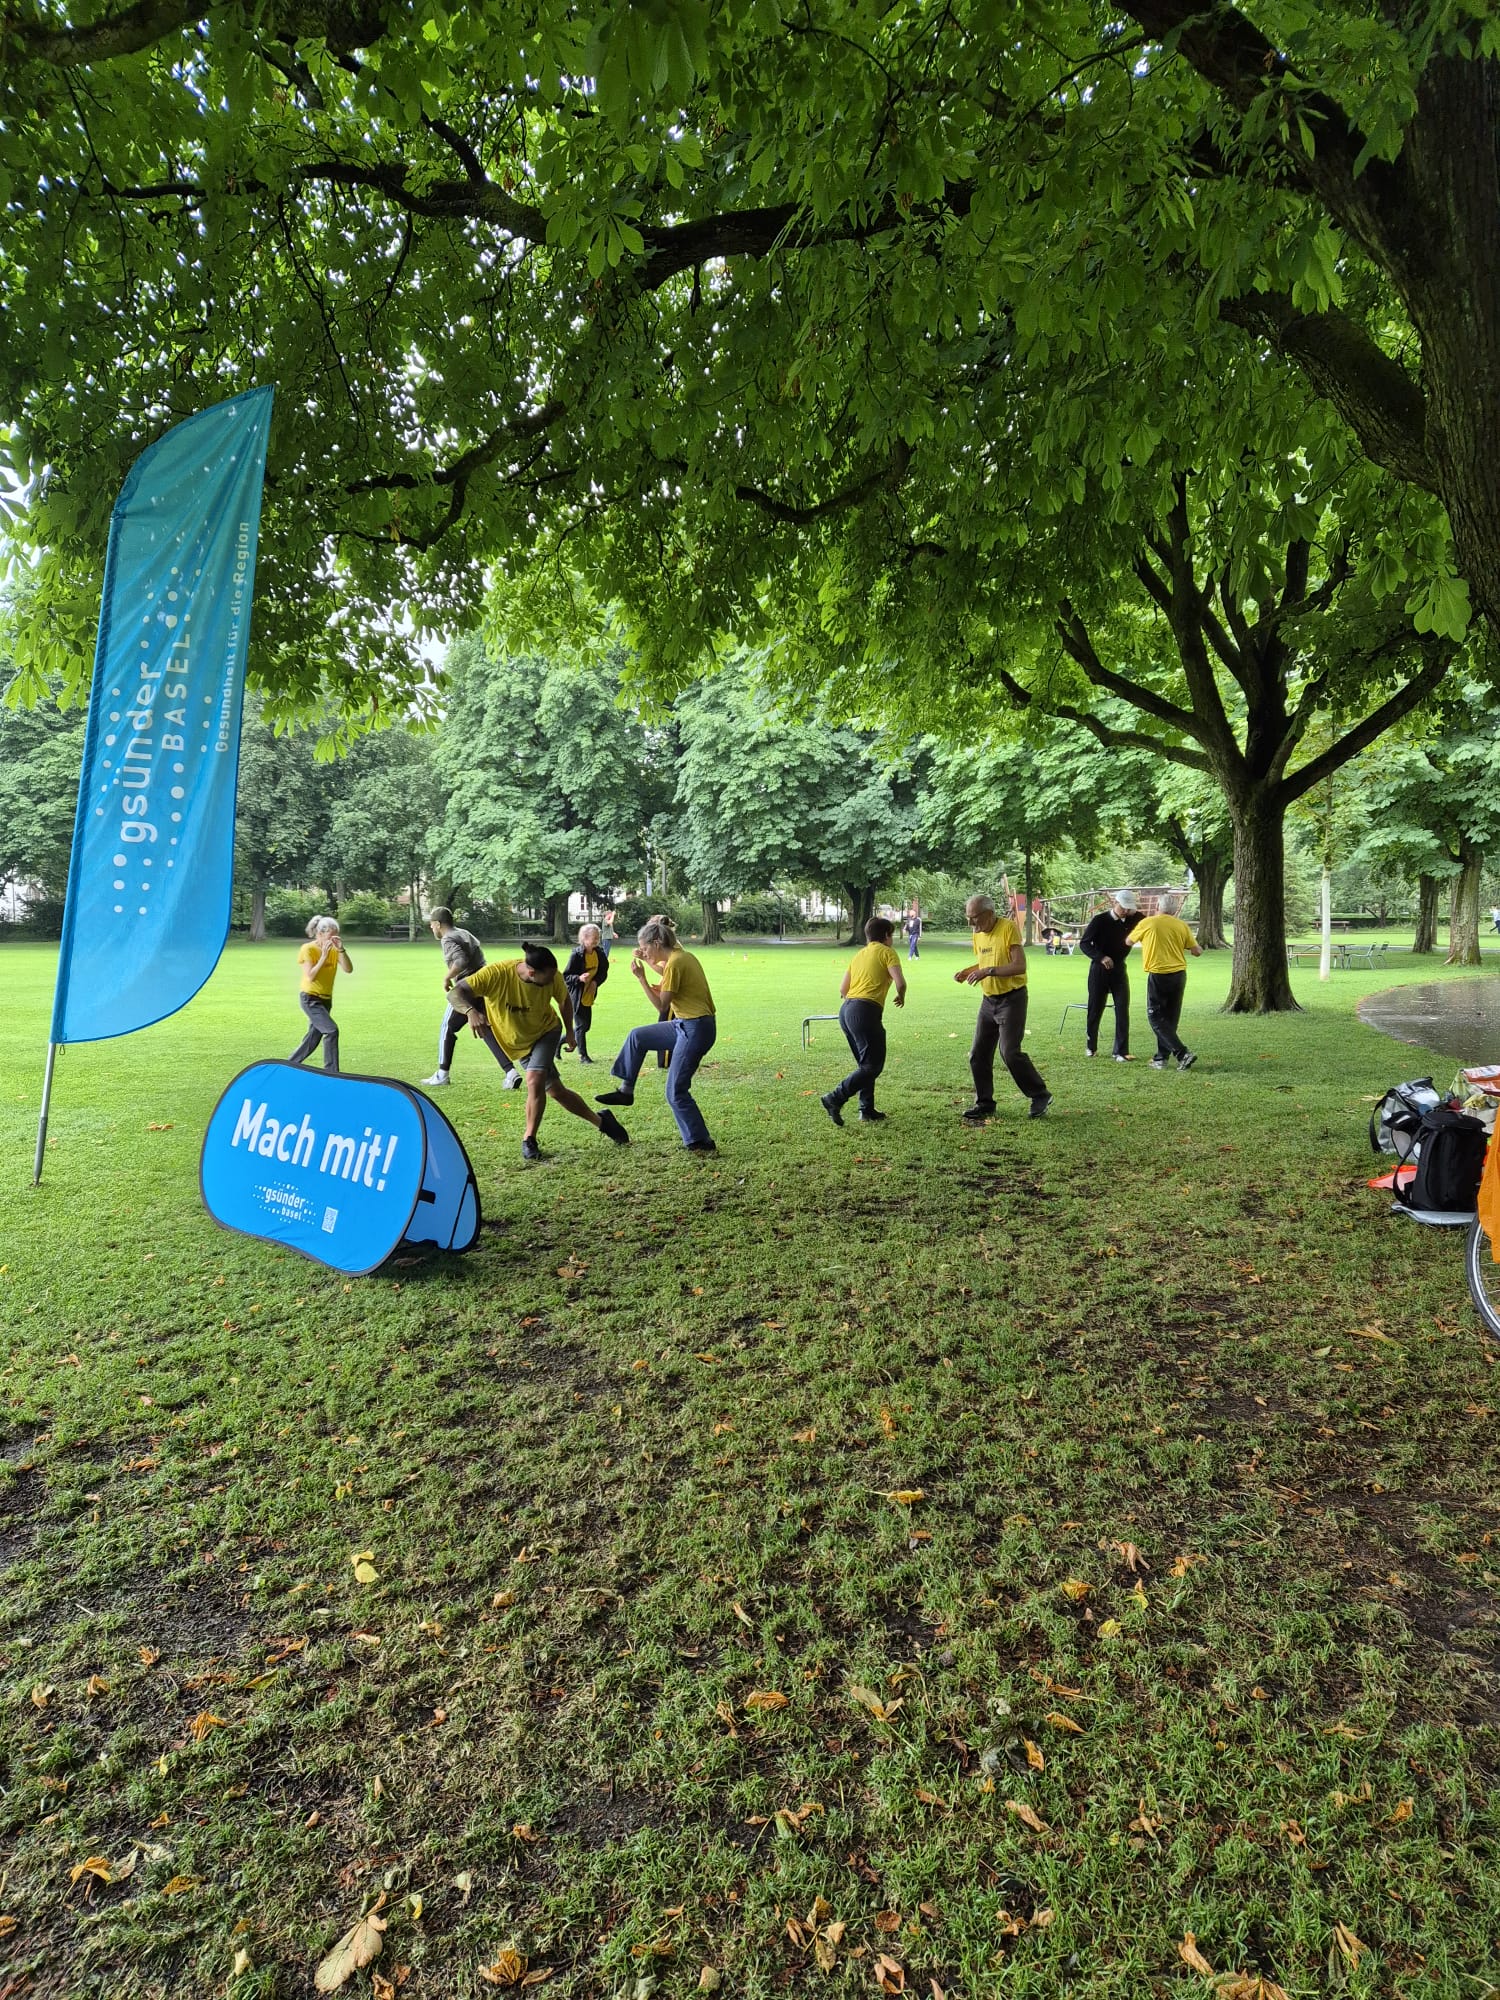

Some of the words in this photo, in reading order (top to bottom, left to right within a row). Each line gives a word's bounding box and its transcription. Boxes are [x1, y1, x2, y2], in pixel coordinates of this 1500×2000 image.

[232, 521, 250, 584] Region
[230, 590, 243, 616] die
[227, 622, 239, 649] für
[161, 633, 191, 751] BASEL
[214, 652, 237, 753] Gesundheit
[113, 661, 162, 844] gsünder
[231, 1098, 316, 1168] Mach
[319, 1126, 399, 1192] mit!
[264, 1187, 306, 1210] gsünder
[281, 1205, 302, 1221] basel
